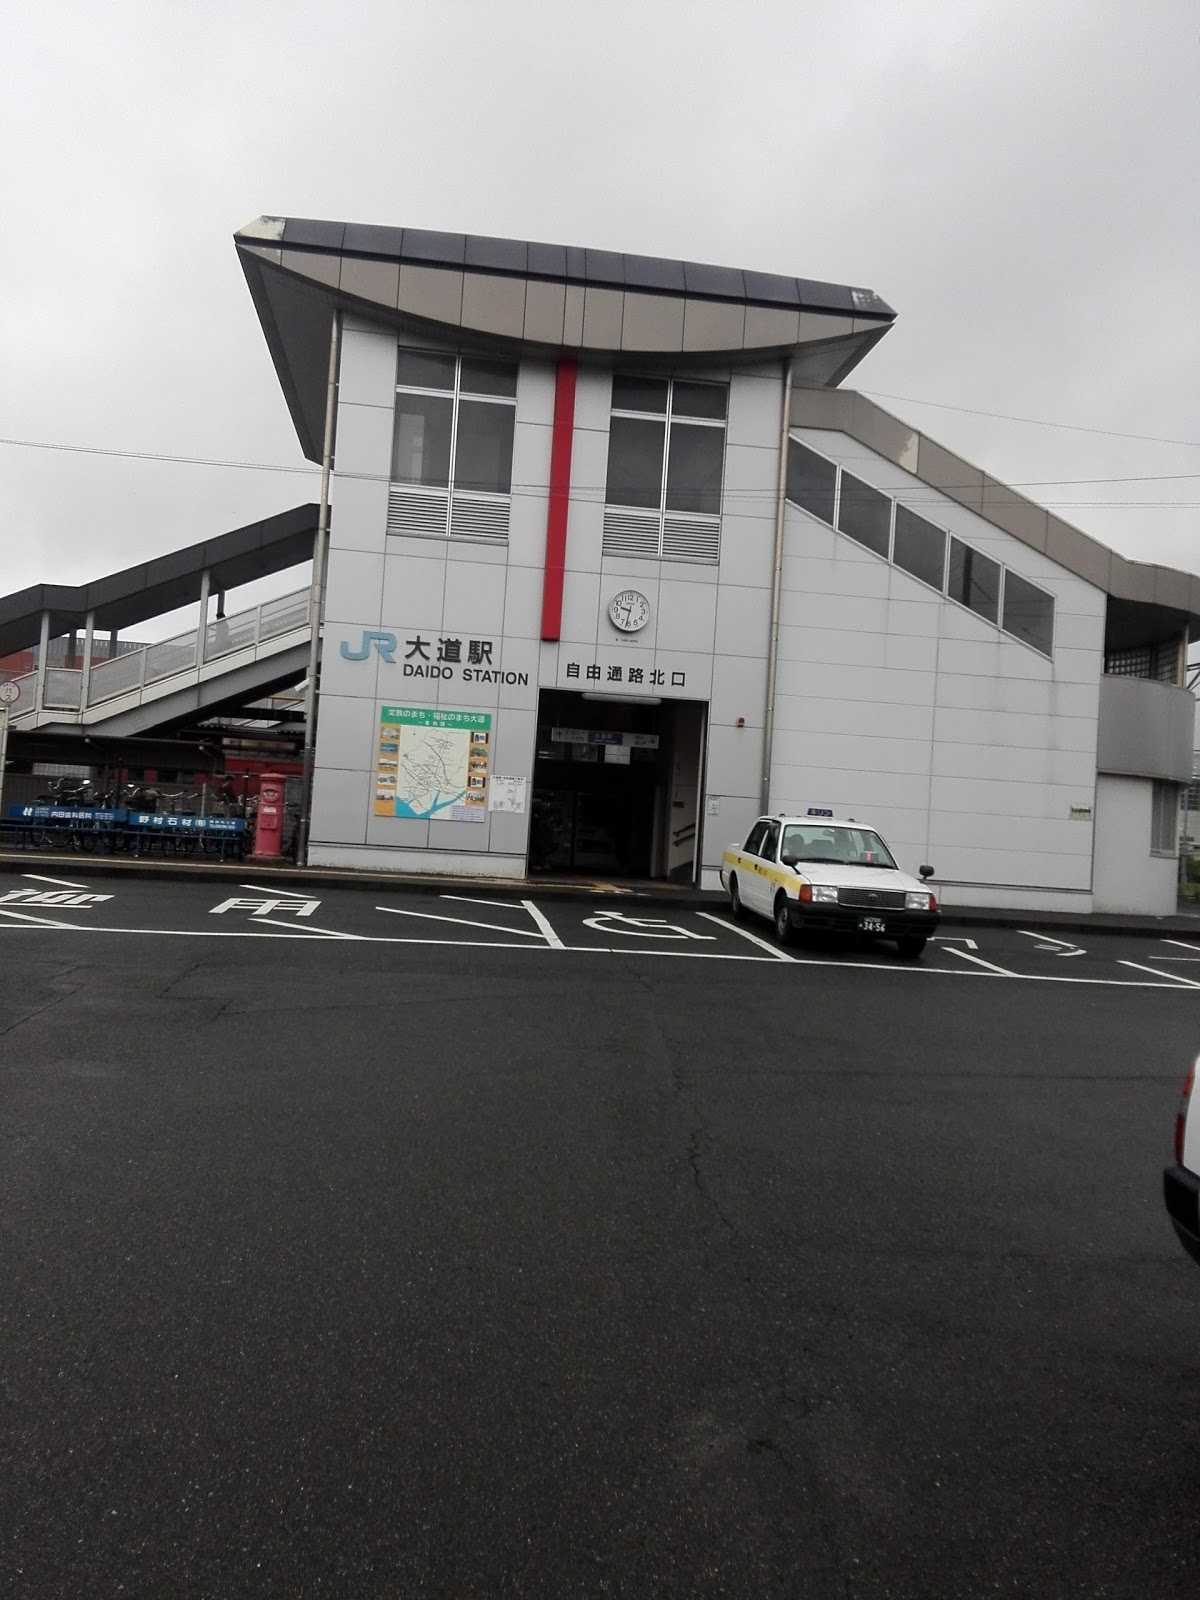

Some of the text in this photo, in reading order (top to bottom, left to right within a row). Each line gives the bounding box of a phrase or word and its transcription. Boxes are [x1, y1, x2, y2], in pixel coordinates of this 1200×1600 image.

[340, 631, 397, 664] JR
[404, 635, 493, 665] 大道駅
[403, 663, 529, 686] DAIDO STATION
[566, 662, 686, 687] 自由通路北口
[208, 897, 322, 916] 用
